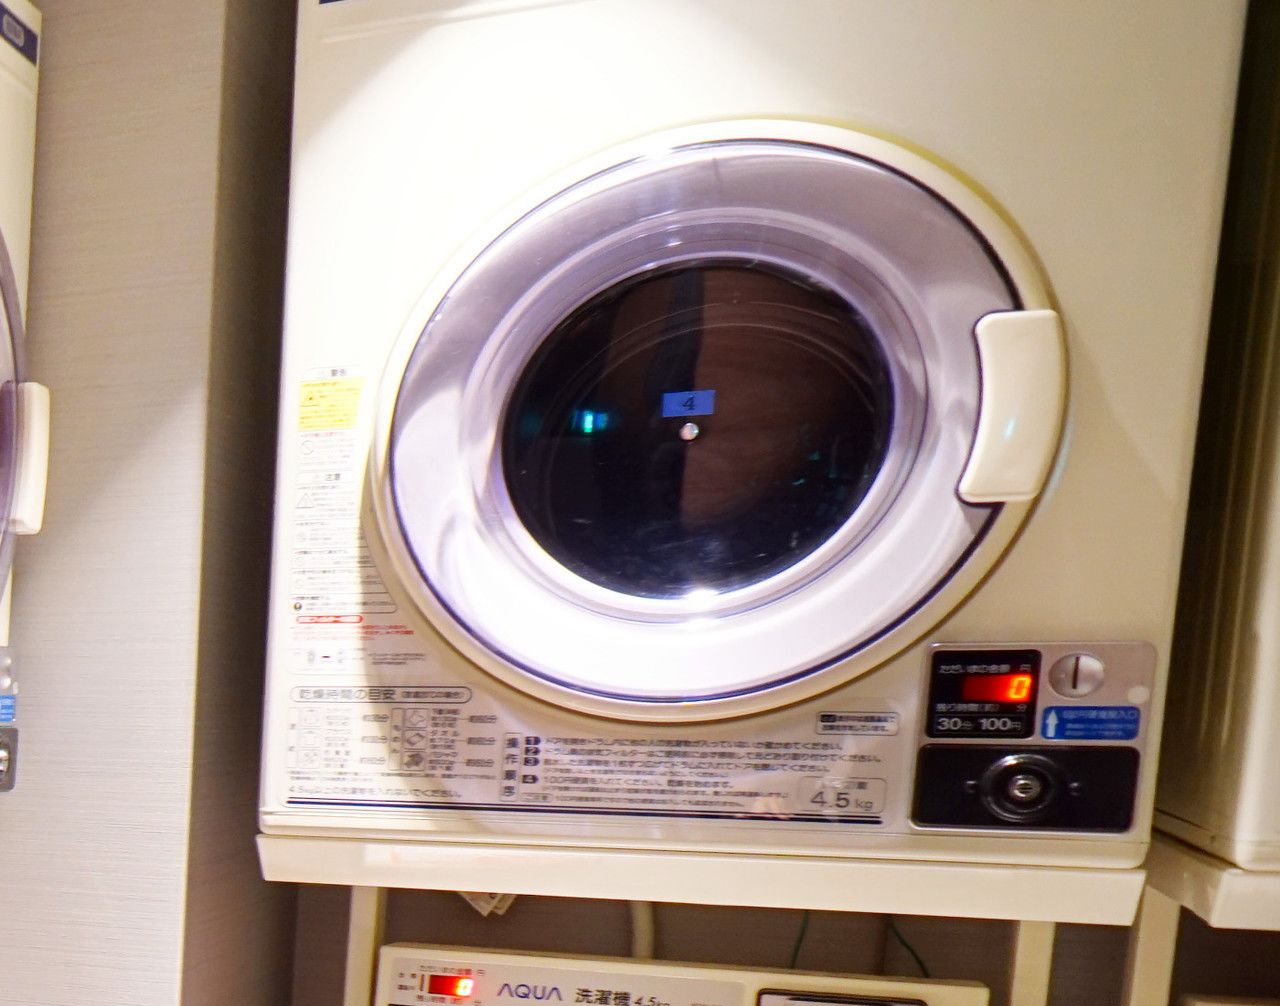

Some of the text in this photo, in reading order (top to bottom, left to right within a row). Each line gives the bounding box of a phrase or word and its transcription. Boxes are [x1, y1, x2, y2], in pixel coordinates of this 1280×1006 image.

[1008, 676, 1033, 700] 0
[809, 789, 874, 812] 4.5kg
[496, 982, 564, 1002] AQUA
